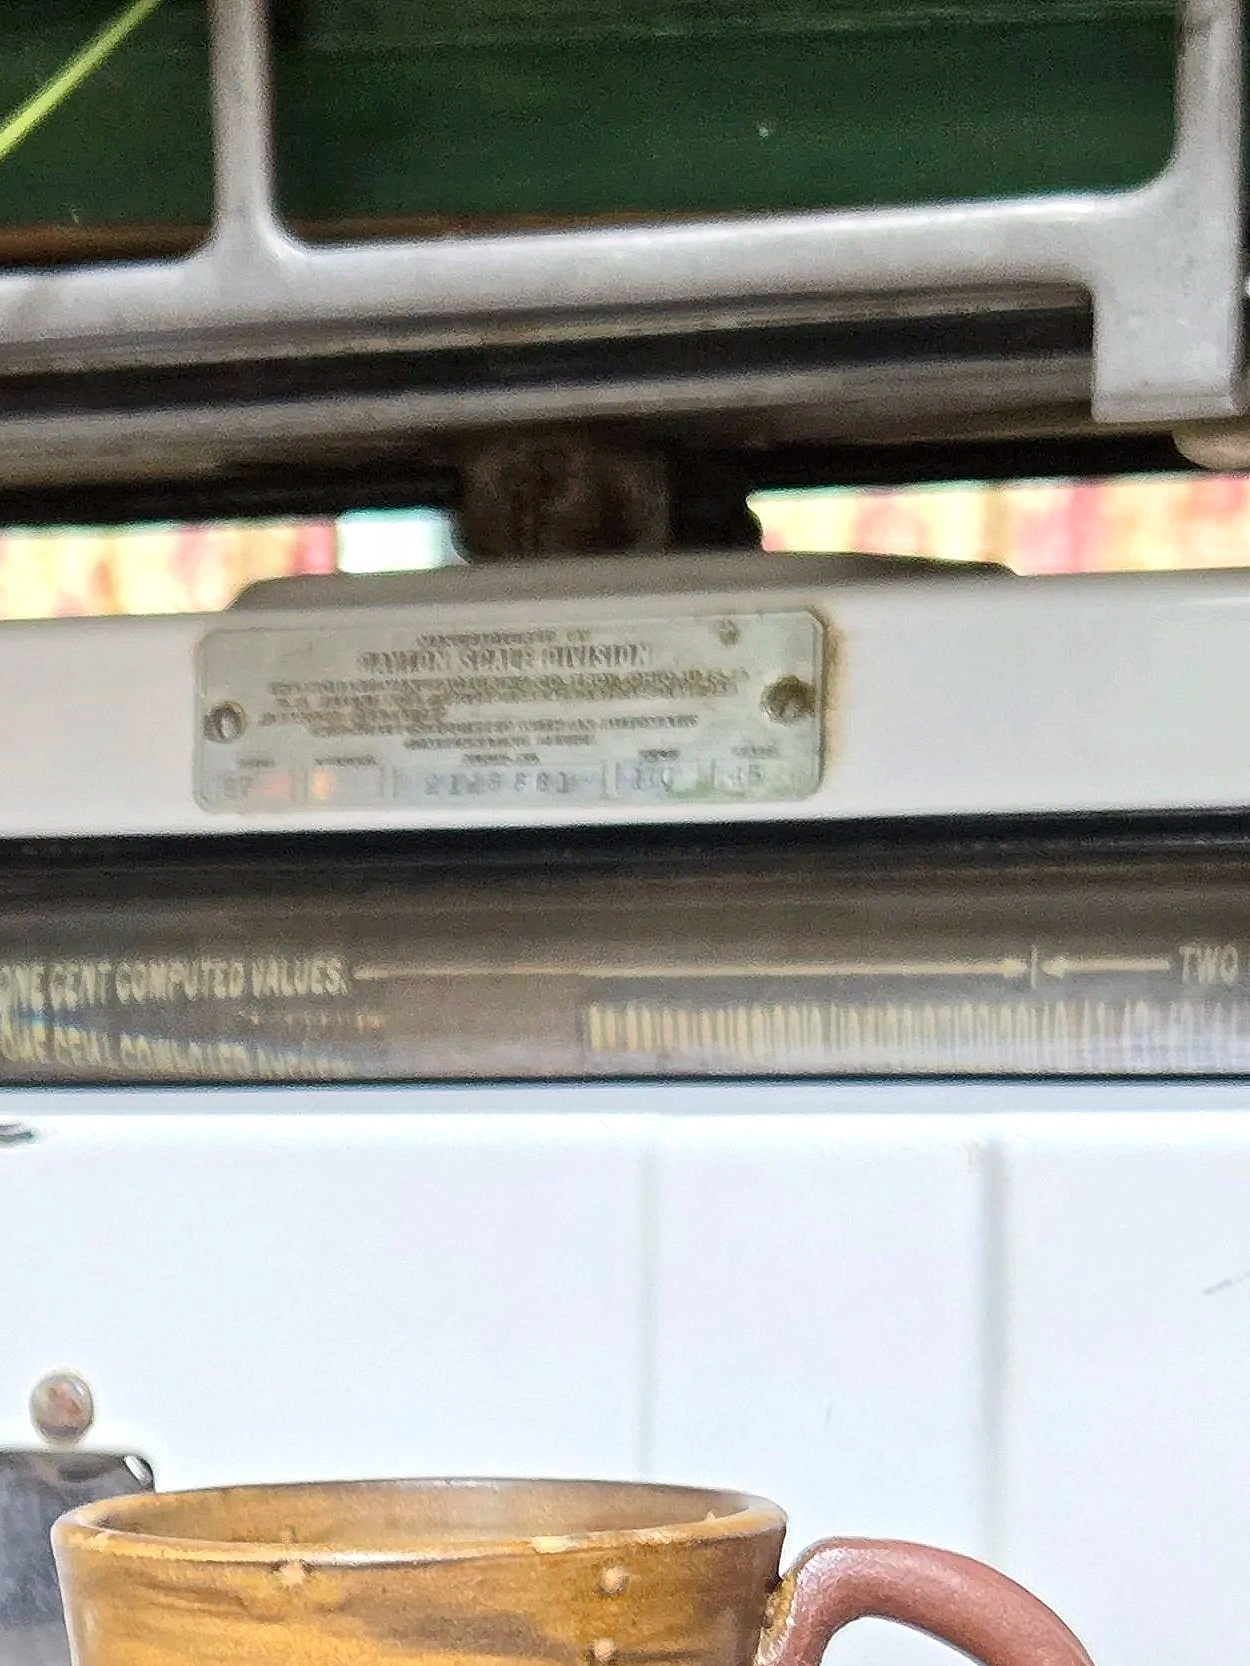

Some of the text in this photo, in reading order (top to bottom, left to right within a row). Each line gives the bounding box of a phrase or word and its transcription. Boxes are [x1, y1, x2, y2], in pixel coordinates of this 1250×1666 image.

[50, 960, 112, 1009] CENT
[116, 958, 246, 1003] COMPUTED
[1179, 943, 1239, 984] TWO
